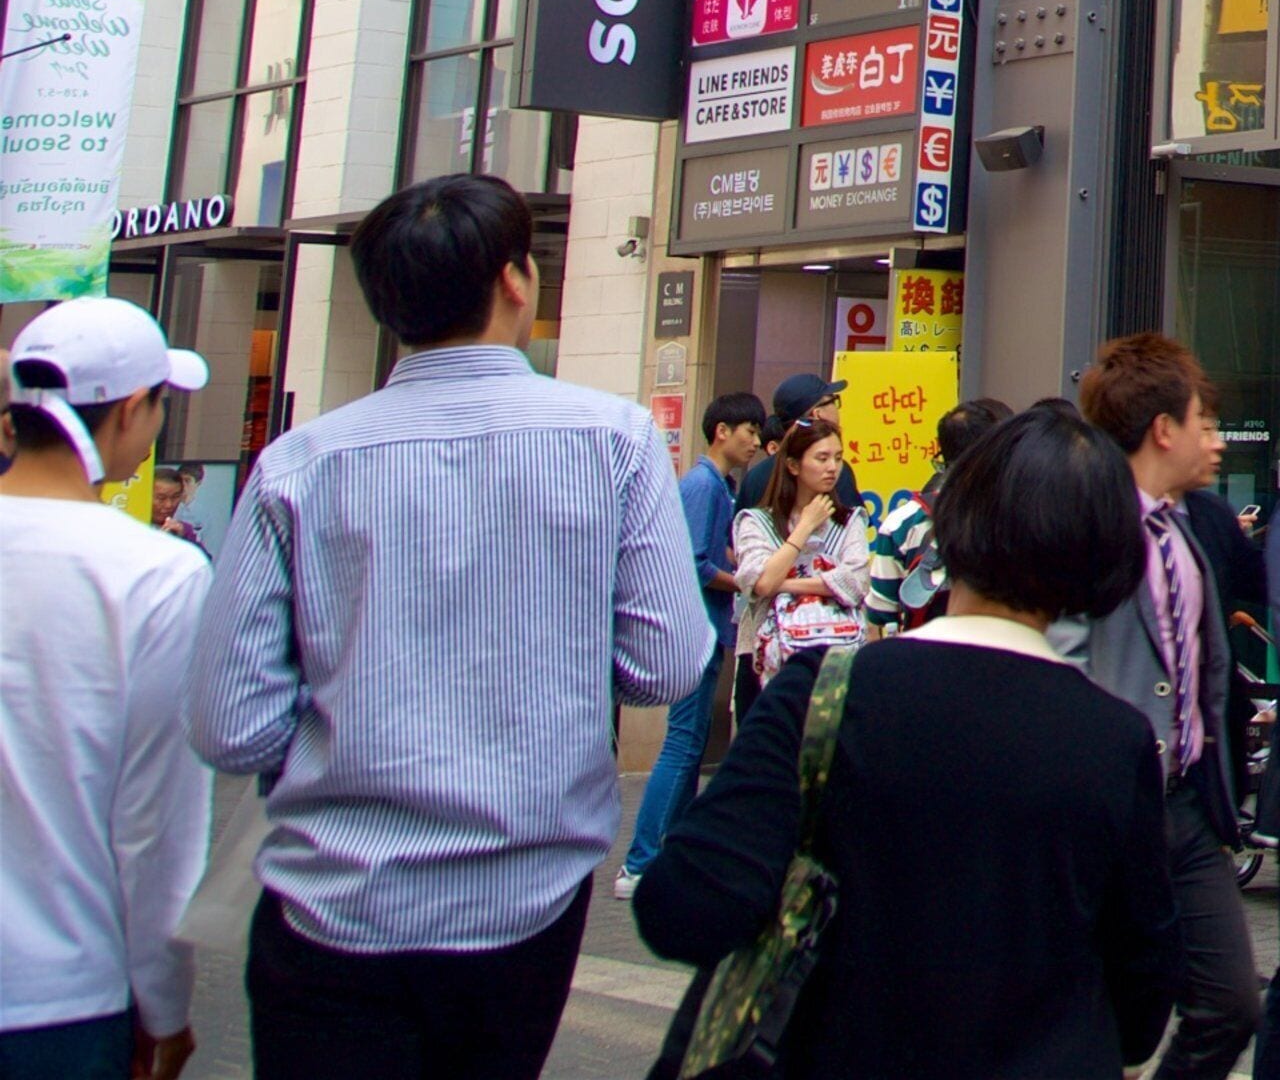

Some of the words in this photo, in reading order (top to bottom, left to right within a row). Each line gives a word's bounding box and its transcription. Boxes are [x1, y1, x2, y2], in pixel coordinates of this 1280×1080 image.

[928, 22, 958, 55] 元
[697, 73, 728, 96] LINE
[730, 63, 789, 89] FRIENDS
[858, 42, 915, 90] 白丁
[925, 75, 954, 110] ¥
[695, 95, 787, 127] CAFE&STORE
[859, 149, 873, 181] $
[882, 146, 898, 179] €
[922, 131, 948, 168] €
[709, 169, 761, 197] CM빌딩
[814, 159, 829, 185] 元
[837, 153, 851, 185] ¥
[692, 193, 775, 221] (주)씨엠브라이트
[809, 192, 845, 211] MONEY
[845, 186, 898, 207] EXCHANGE
[918, 184, 944, 226] $
[667, 362, 675, 381] 9
[1226, 430, 1271, 442] FRIENDS
